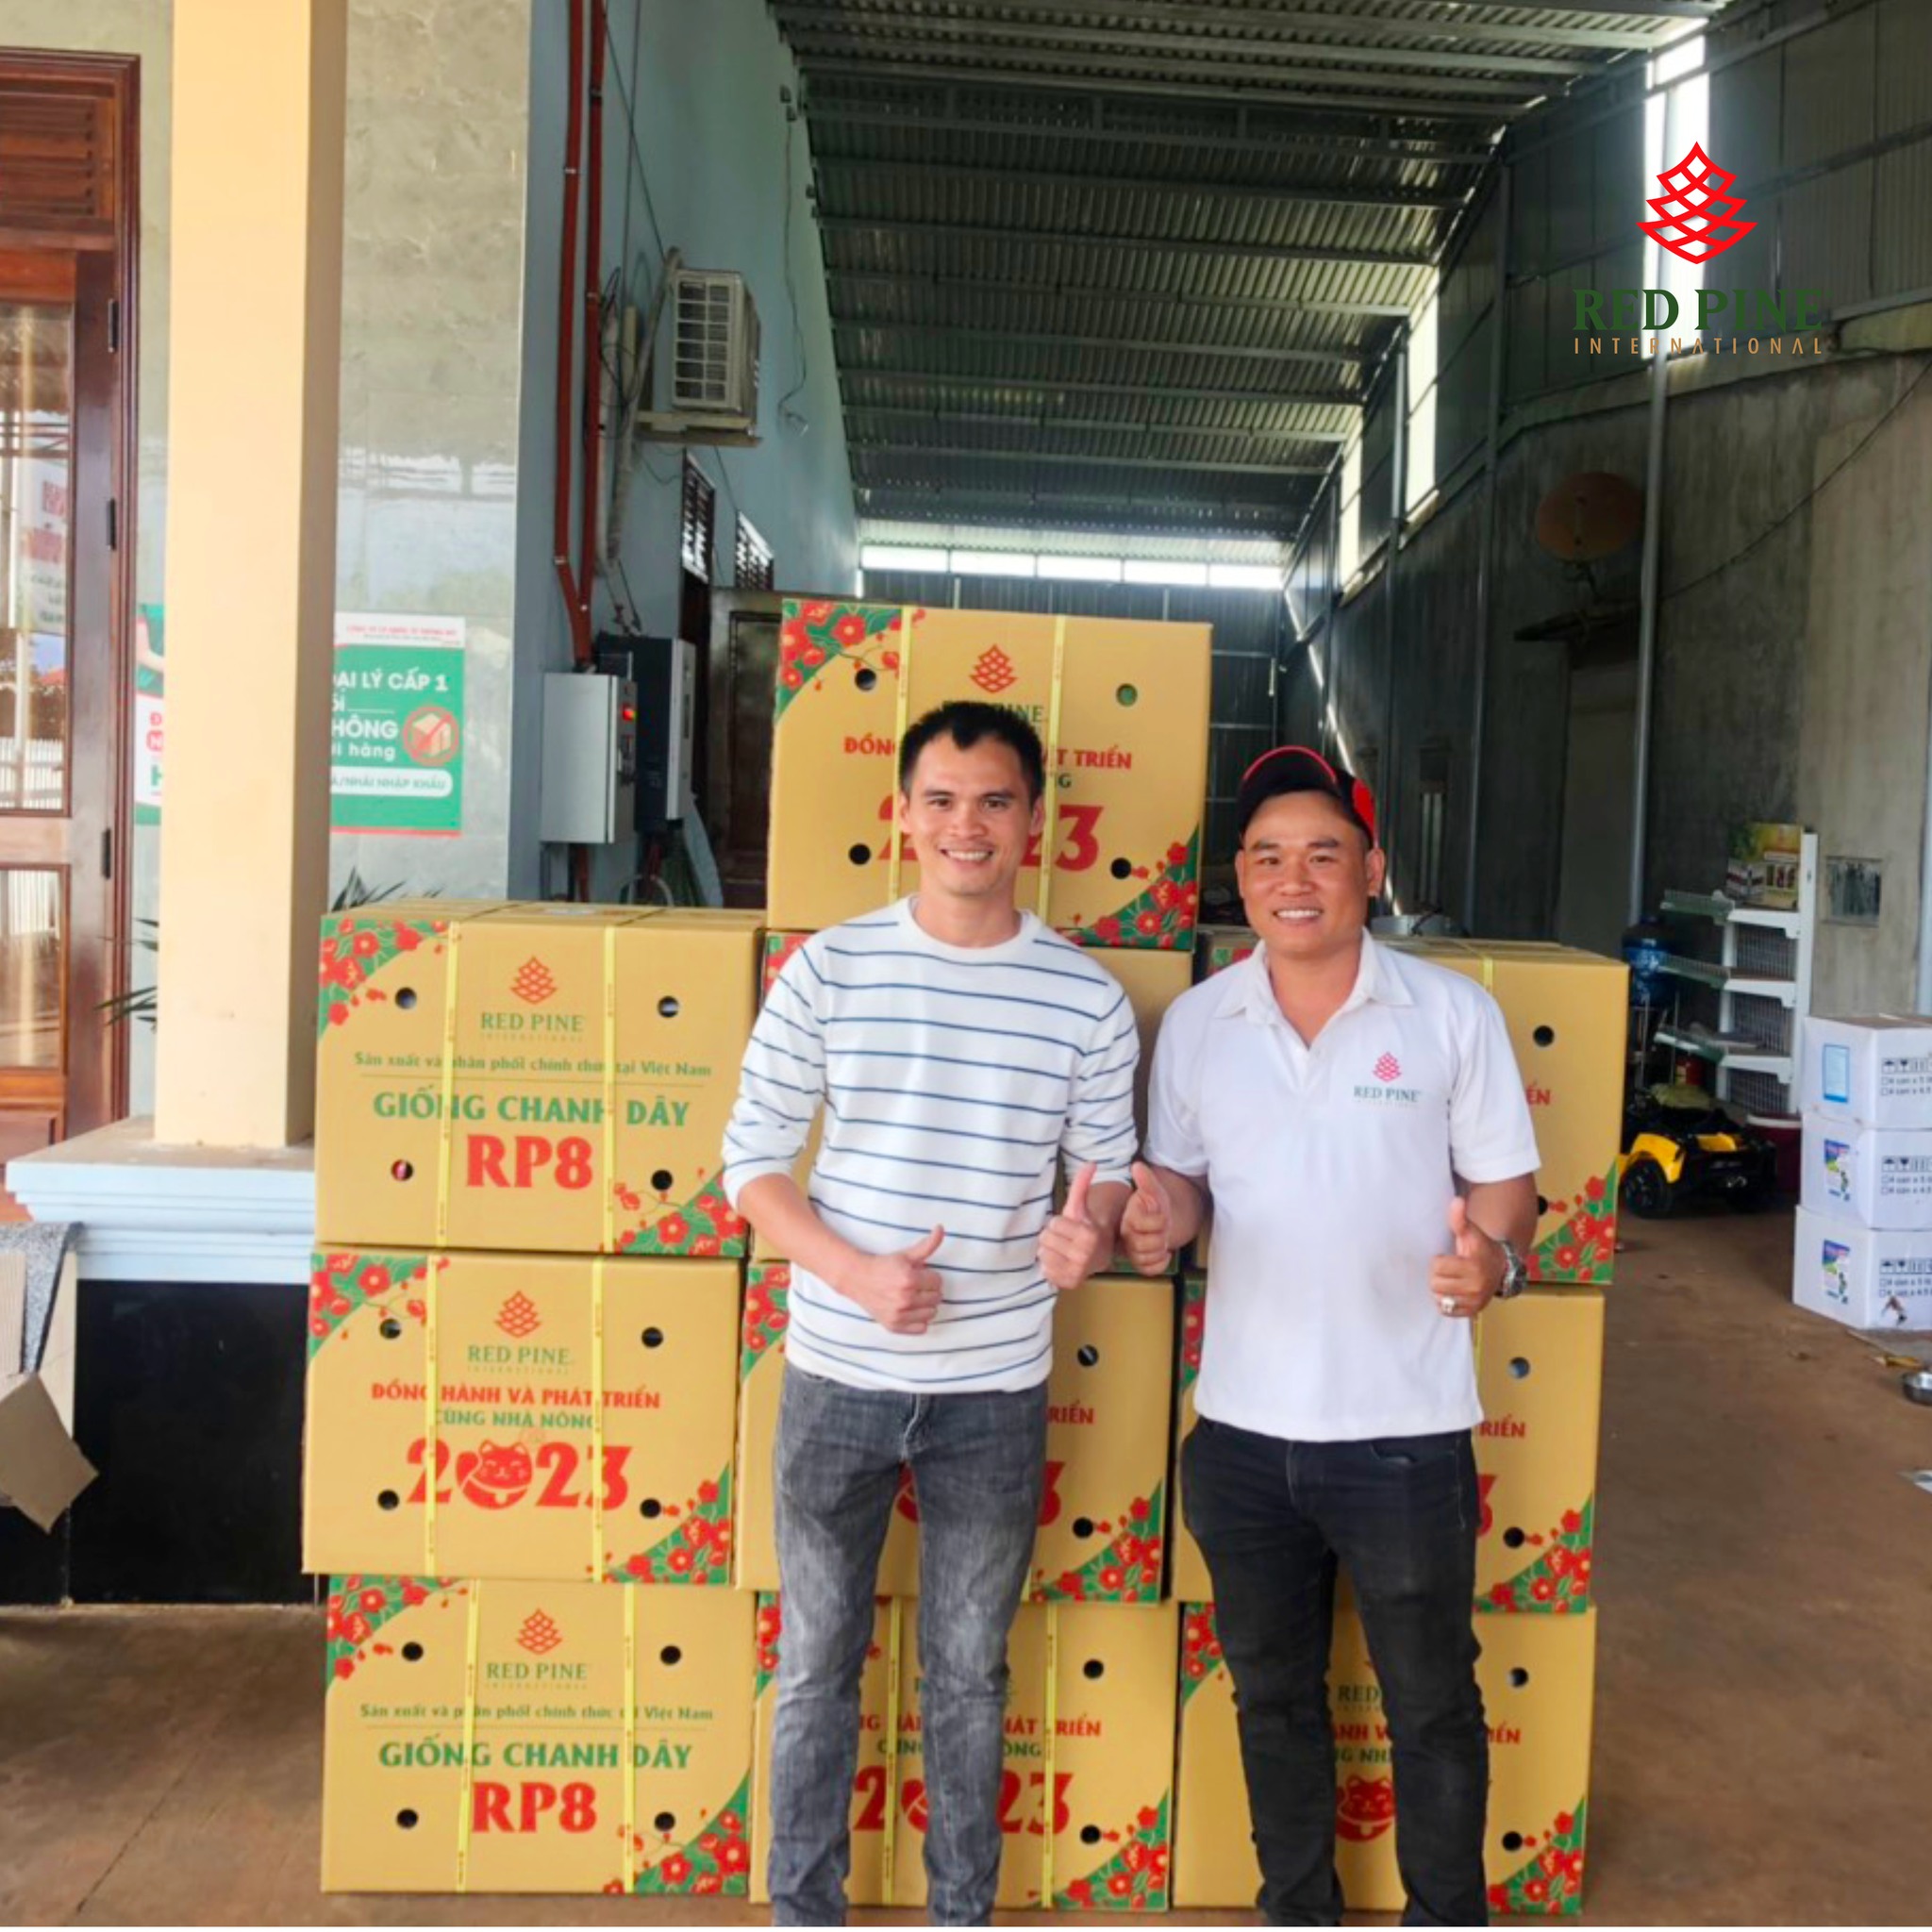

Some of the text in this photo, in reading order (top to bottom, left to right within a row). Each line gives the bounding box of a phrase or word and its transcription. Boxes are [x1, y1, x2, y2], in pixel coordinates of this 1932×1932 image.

[361, 667, 383, 690] LÝ
[388, 666, 430, 691] CẤP
[435, 675, 448, 691] 1
[332, 713, 398, 740] HÔNG
[480, 1012, 584, 1033] RED PINE
[675, 1062, 712, 1076] Nam
[374, 1085, 486, 1121] GIỐNG
[626, 1095, 690, 1126] DÂY
[1354, 1085, 1419, 1103] RED PINE
[466, 1134, 593, 1190] RP8
[467, 1344, 571, 1365] RED PINE
[441, 1382, 501, 1404] HÀNH
[508, 1384, 535, 1405] VÀ
[541, 1387, 592, 1407] PHÁT
[492, 1408, 534, 1428] NHÀ
[1047, 1400, 1095, 1425] RIỂN
[1478, 1414, 1526, 1439] RIỂN
[486, 1662, 588, 1681] RED PINE
[678, 1707, 713, 1721] Nam
[1055, 1712, 1101, 1736] RIỂN
[379, 1733, 692, 1769] GIỐNG CHANH DÂY
[471, 1781, 598, 1834] RP8
